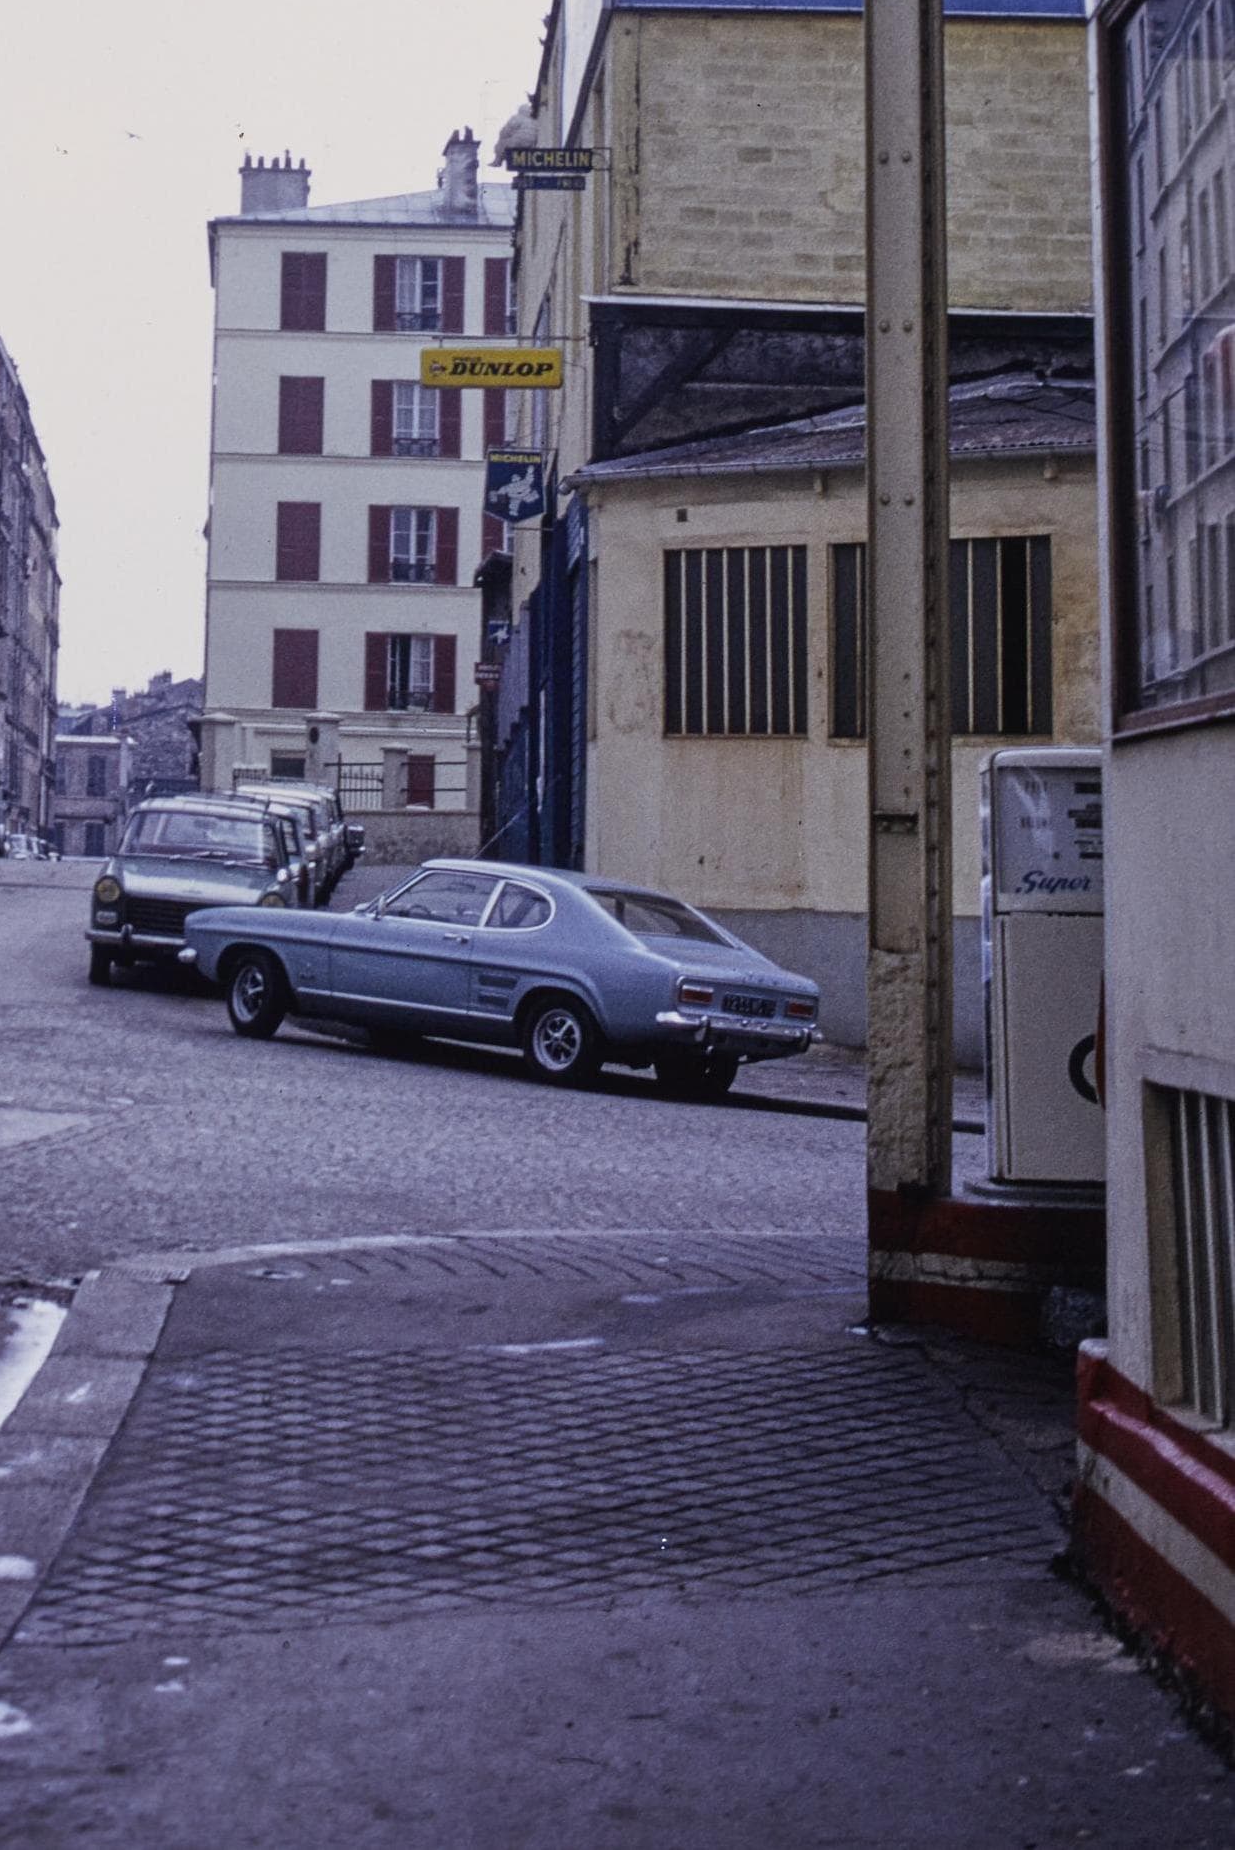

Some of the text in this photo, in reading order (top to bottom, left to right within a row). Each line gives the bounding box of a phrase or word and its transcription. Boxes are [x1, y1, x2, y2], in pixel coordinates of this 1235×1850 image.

[512, 150, 590, 167] MICHELIN
[449, 360, 554, 377] DUNLOP
[1014, 870, 1091, 894] Super
